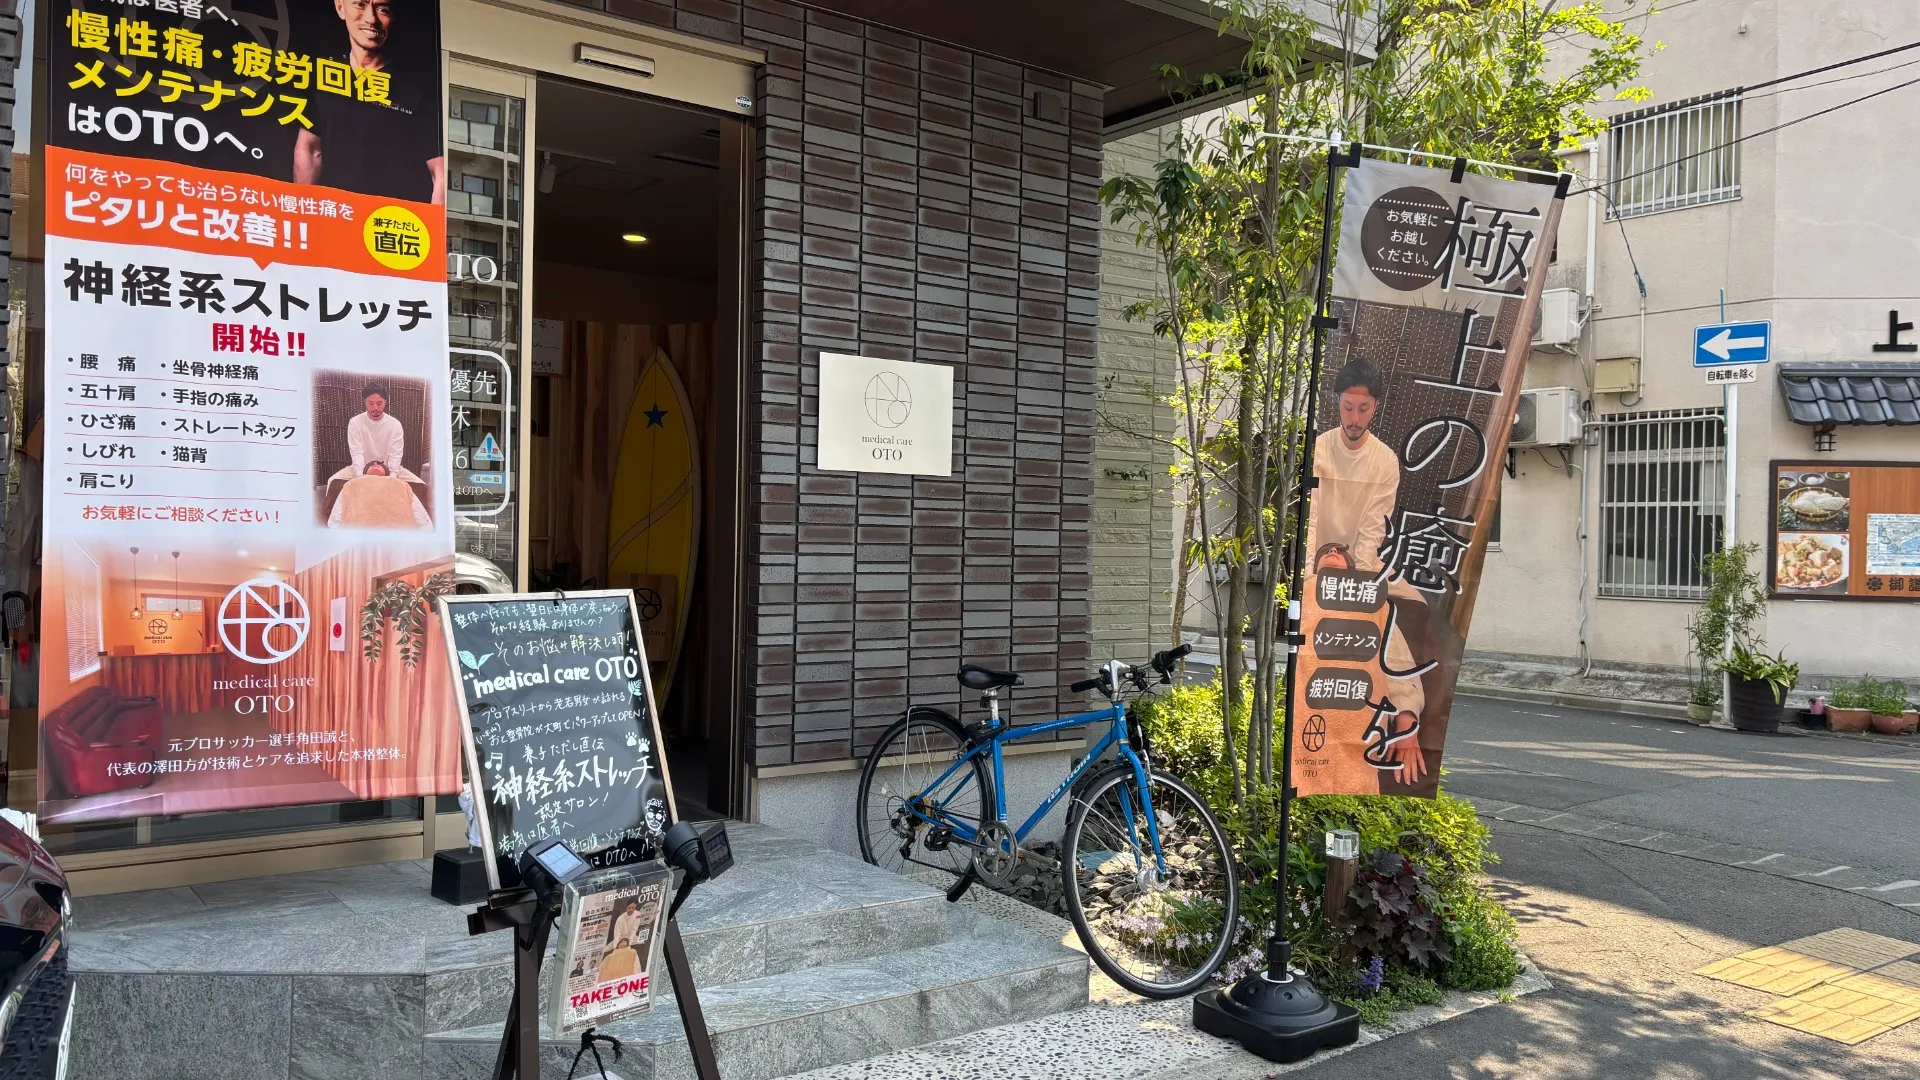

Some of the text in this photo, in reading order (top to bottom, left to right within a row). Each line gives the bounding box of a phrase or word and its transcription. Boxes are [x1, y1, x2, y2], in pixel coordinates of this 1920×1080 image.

[66, 9, 393, 107] 慢性痛・疲労回復
[68, 60, 314, 129] メンテナンス
[68, 103, 264, 160] はOTOへ。
[65, 162, 355, 221] 何をやっても治らない慢性痛を
[64, 190, 309, 251] ピタリと改善!!
[373, 217, 420, 232] 兼子ただし
[1386, 210, 1438, 227] お気軽に
[374, 231, 420, 258] 直伝
[1390, 230, 1428, 245] お越し
[1377, 247, 1430, 266] ください。
[63, 258, 433, 332] 神経系ストレッチ
[212, 323, 306, 357] 開始!!
[1872, 309, 1918, 352] 上
[1707, 368, 1754, 381] 自転車を除く
[862, 434, 913, 446] medical care
[872, 447, 902, 461] OTO
[82, 505, 280, 524] お気軽にご相談ください！
[1320, 575, 1378, 605] 慢性痛
[1315, 632, 1377, 650] メンテナンス
[213, 674, 315, 691] medical care
[473, 656, 638, 698] medical care OTO
[1309, 678, 1369, 701] 疲労回復
[234, 694, 294, 716] OTO
[167, 731, 355, 753] 元プロサッカー選手角田誠と、
[107, 747, 408, 776] 代表の澤田方が技術とケアを追求した本格整体。
[604, 883, 659, 902] medical care
[638, 891, 660, 904] OTO
[570, 986, 613, 1008] TAKE
[617, 976, 650, 996] ONE
